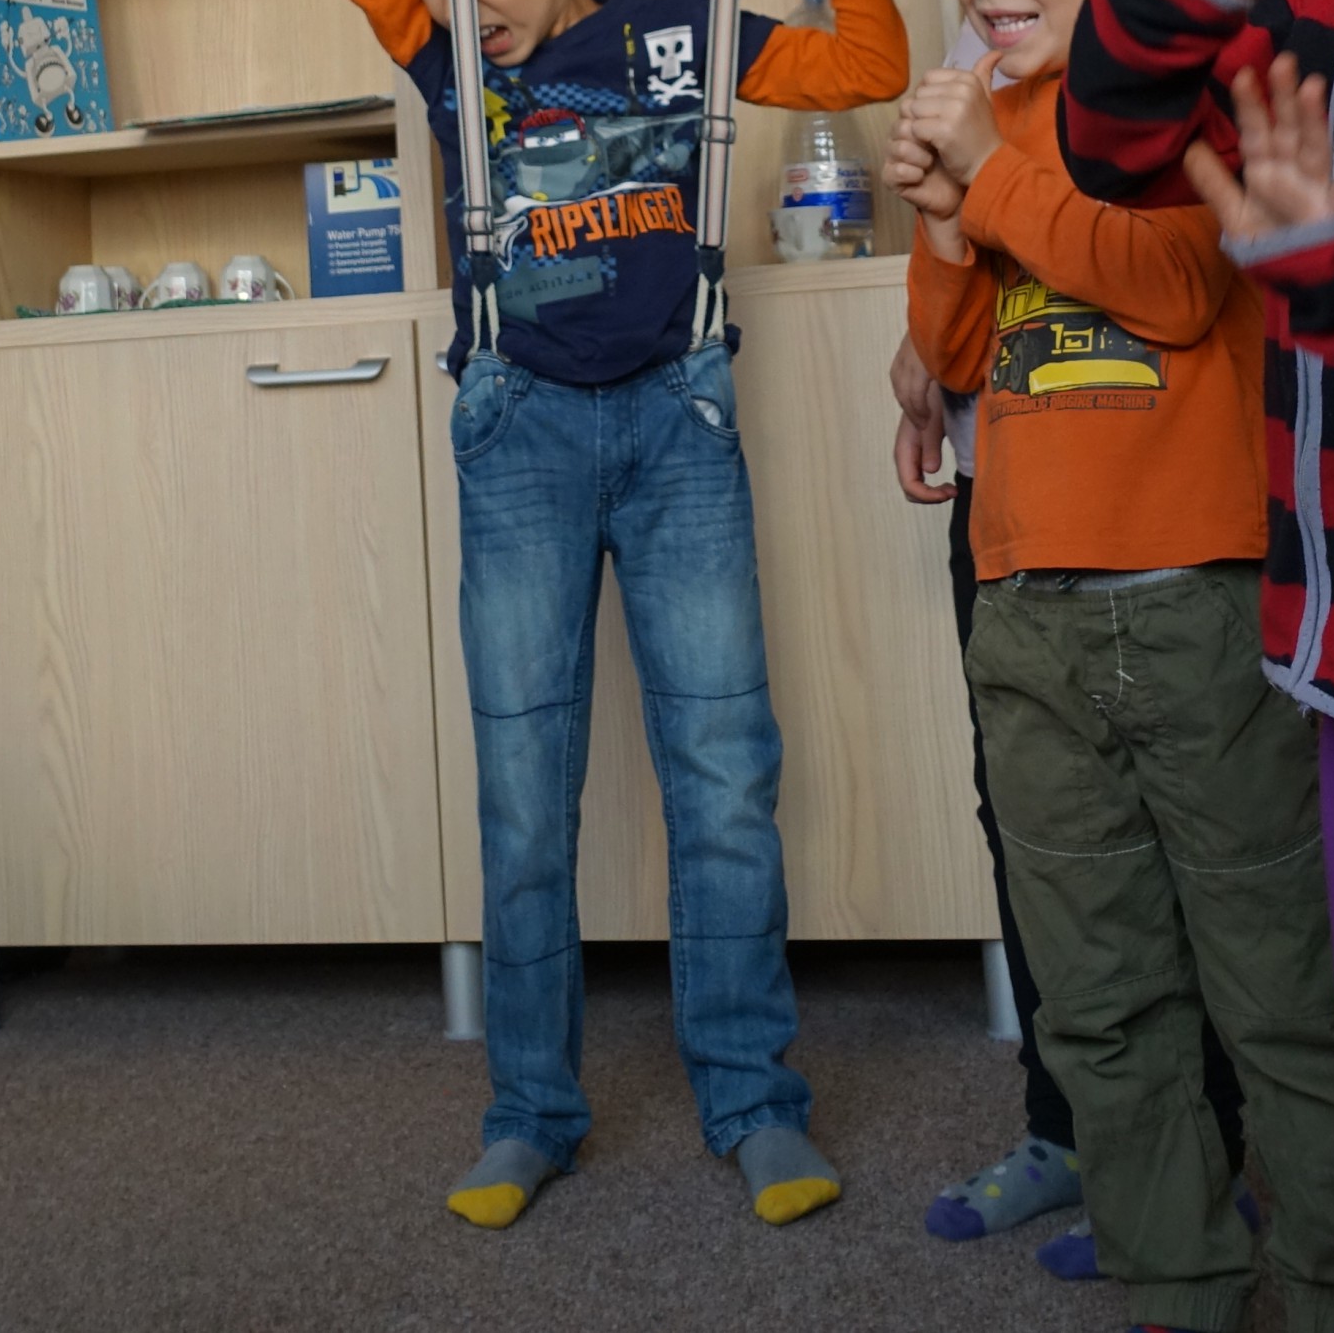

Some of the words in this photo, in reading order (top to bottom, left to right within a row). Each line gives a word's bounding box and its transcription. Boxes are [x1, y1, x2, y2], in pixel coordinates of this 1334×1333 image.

[529, 187, 696, 258] RIPSLINGER
[327, 229, 355, 240] Water
[357, 226, 387, 238] Pump
[1095, 394, 1153, 410] MACHINE
